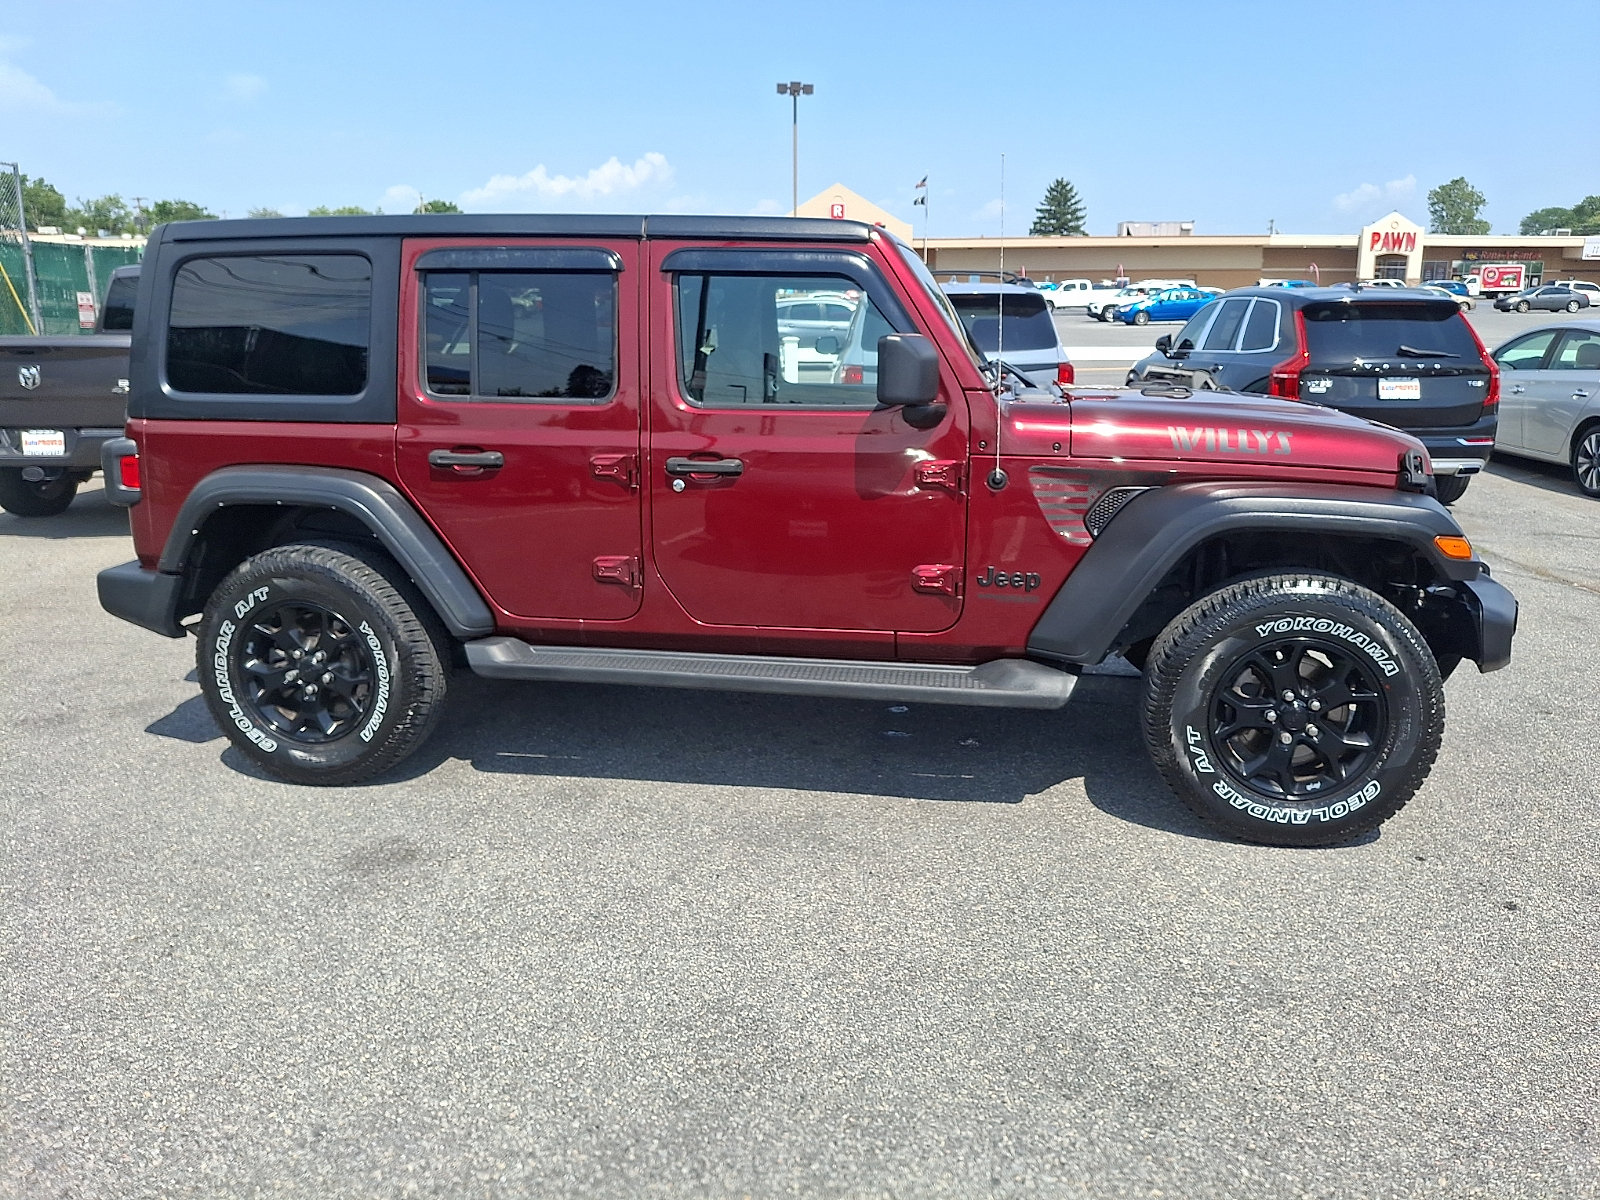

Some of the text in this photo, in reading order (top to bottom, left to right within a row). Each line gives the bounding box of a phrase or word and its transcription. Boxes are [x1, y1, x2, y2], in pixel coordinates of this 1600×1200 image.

[1370, 231, 1417, 251] PAWN
[1167, 426, 1293, 456] WILLYS
[976, 565, 1041, 592] Jeep
[213, 586, 278, 753] GEOLANDAR A/T
[1255, 616, 1400, 677] YOKOHAMA
[359, 620, 390, 743] YOKOHAMA
[1186, 725, 1382, 825] GEOLANDAR A/T
